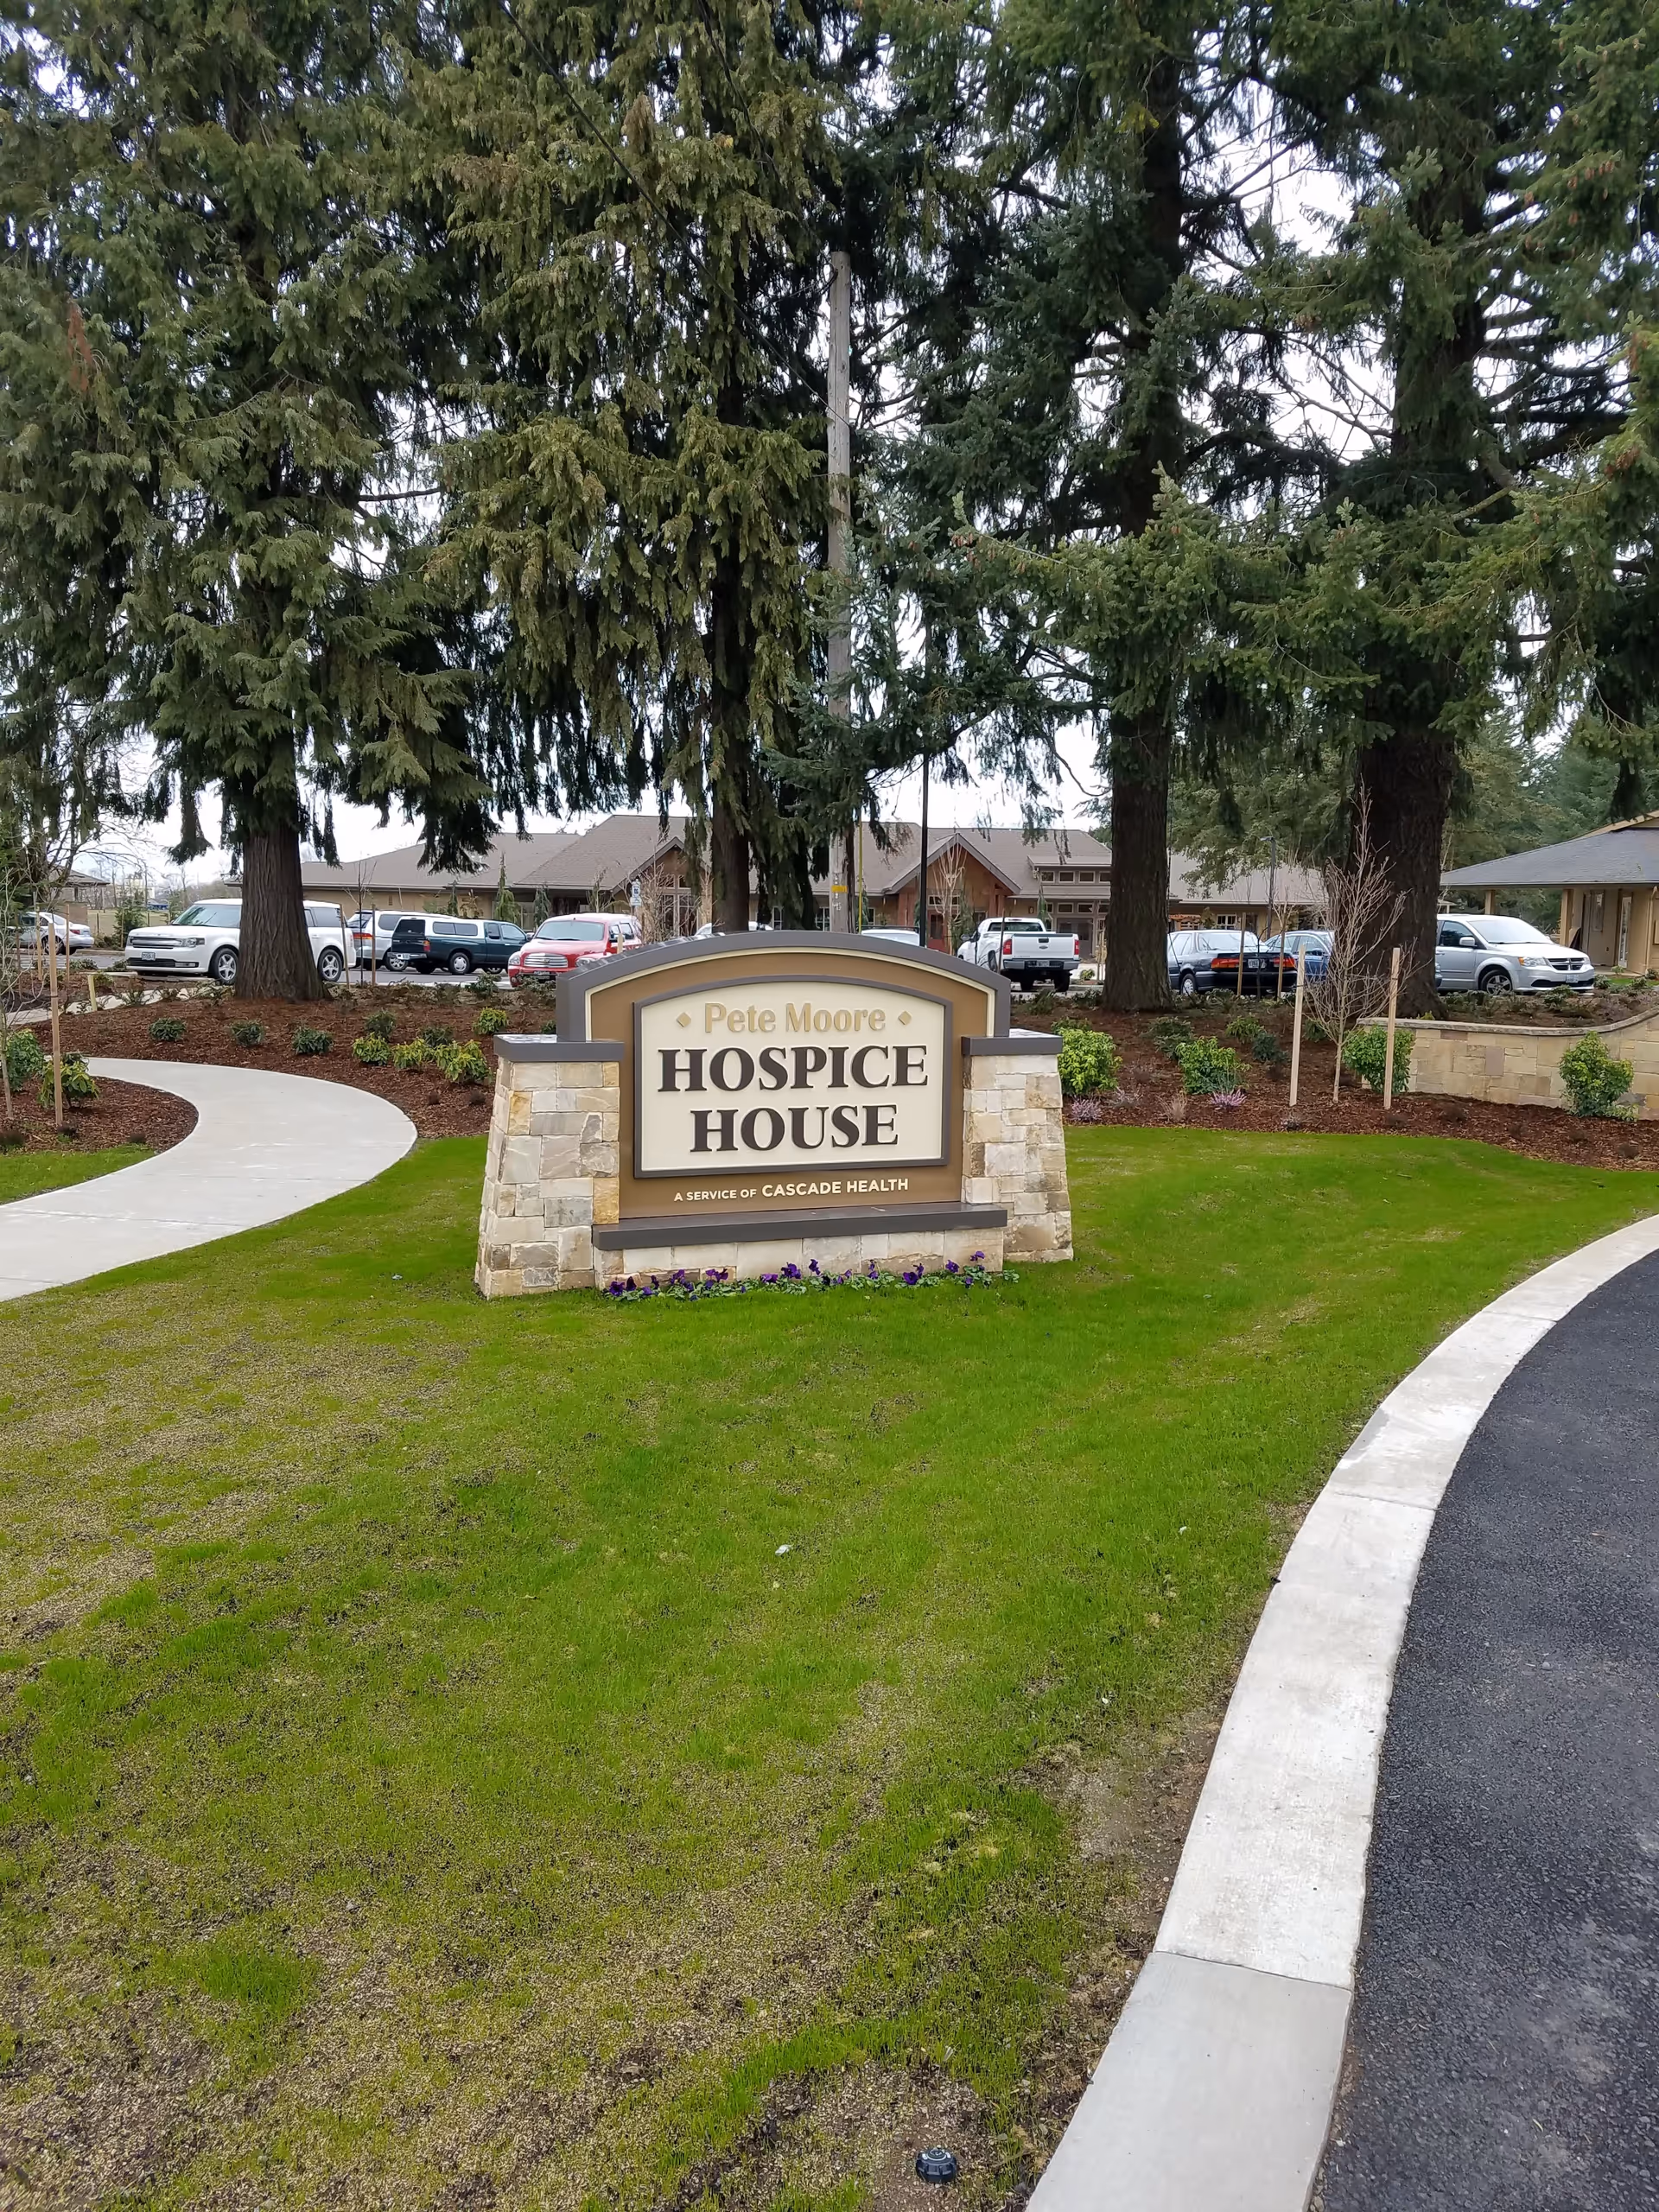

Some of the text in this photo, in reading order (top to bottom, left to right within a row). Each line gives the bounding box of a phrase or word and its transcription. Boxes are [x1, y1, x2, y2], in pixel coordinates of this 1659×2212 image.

[704, 1002, 886, 1033] Pete Moore
[658, 1045, 928, 1092] HOSPICE
[690, 1104, 899, 1153] HOUSE
[673, 1179, 909, 1202] A SERVICE OF CASCADE HEALTH
